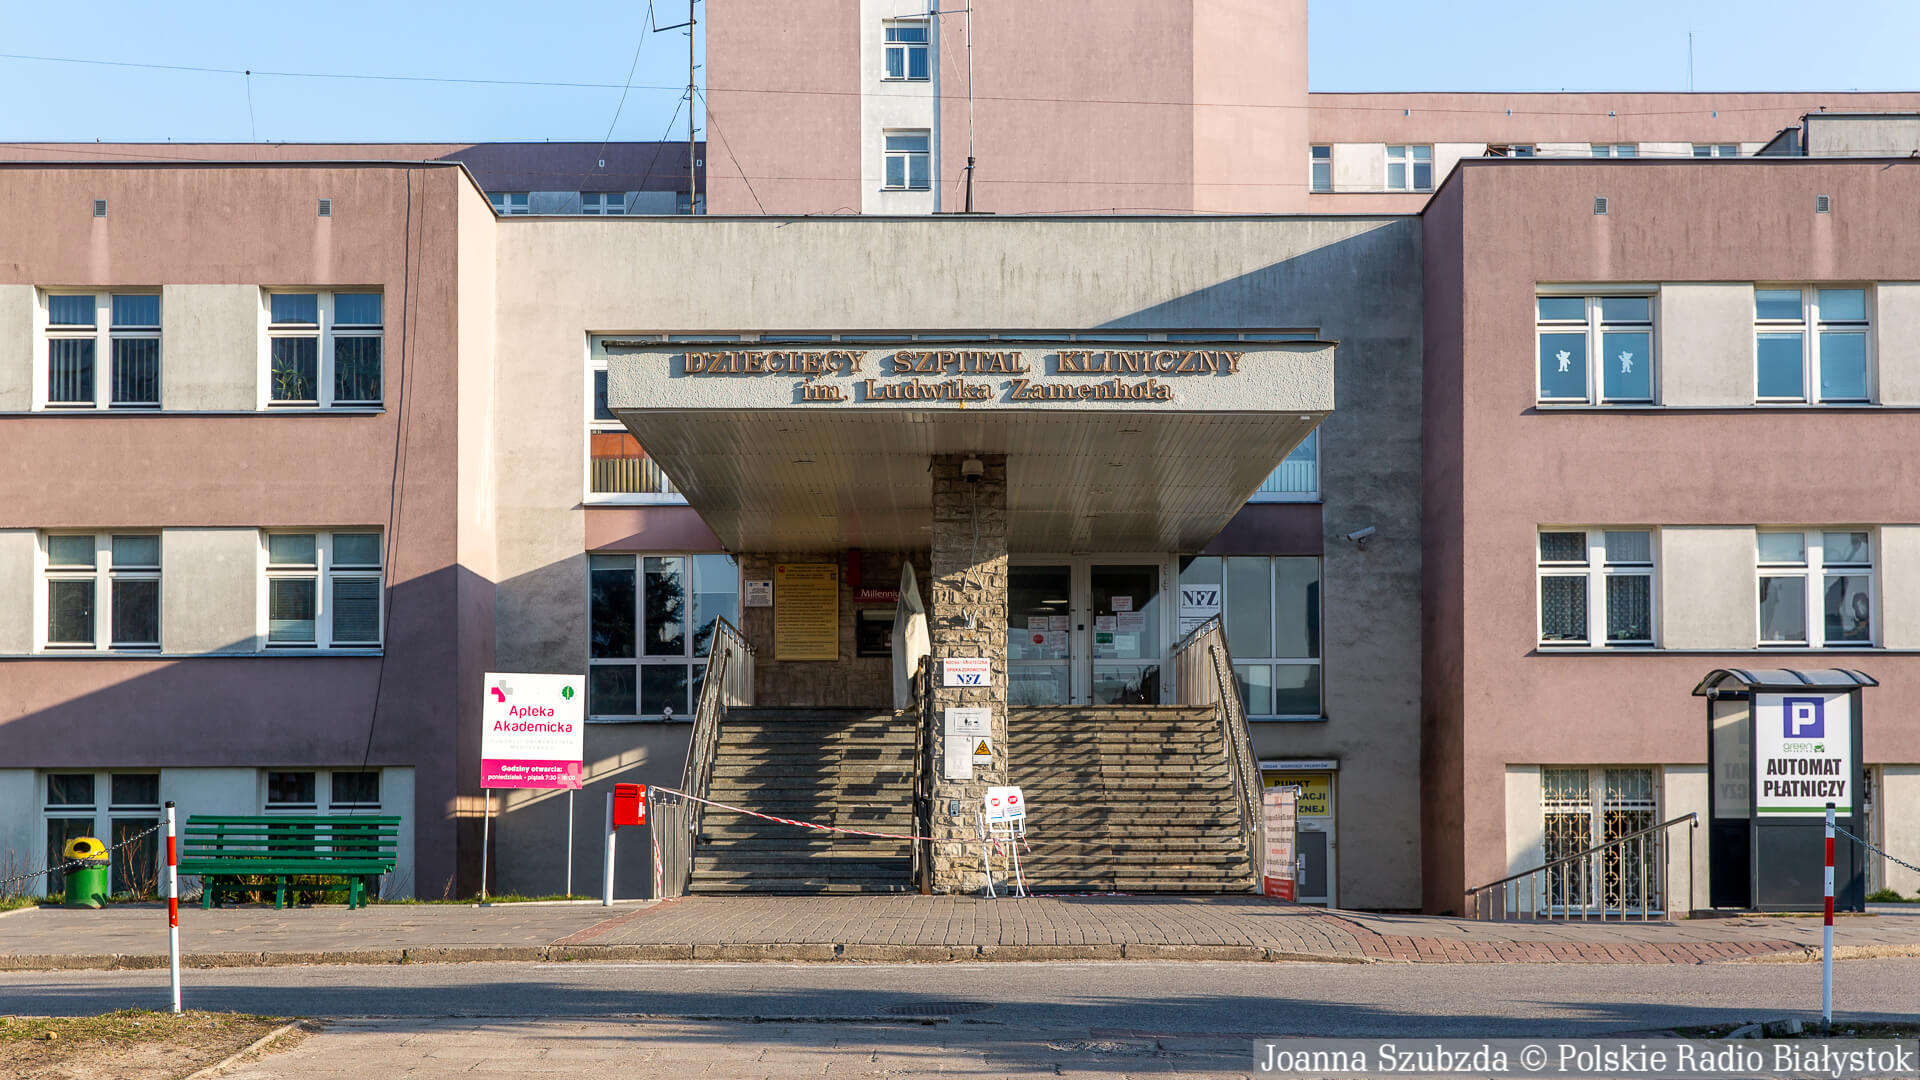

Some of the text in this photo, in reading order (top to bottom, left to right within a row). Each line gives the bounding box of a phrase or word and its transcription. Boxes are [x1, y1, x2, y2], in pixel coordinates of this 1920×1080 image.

[683, 351, 1245, 378] DZIECIĘCY SZPITAL KLINICZNY
[801, 378, 1175, 401] im. Ludwika Zamenhofa
[1181, 590, 1219, 606] NFZ
[957, 674, 981, 685] NFZ
[509, 705, 554, 718] Apteka
[1791, 701, 1816, 736] P
[493, 720, 573, 733] Akademicka
[501, 765, 529, 773] Godziny
[1766, 758, 1842, 776] AUTOMAT
[1763, 780, 1846, 797] PŁATNICZY
